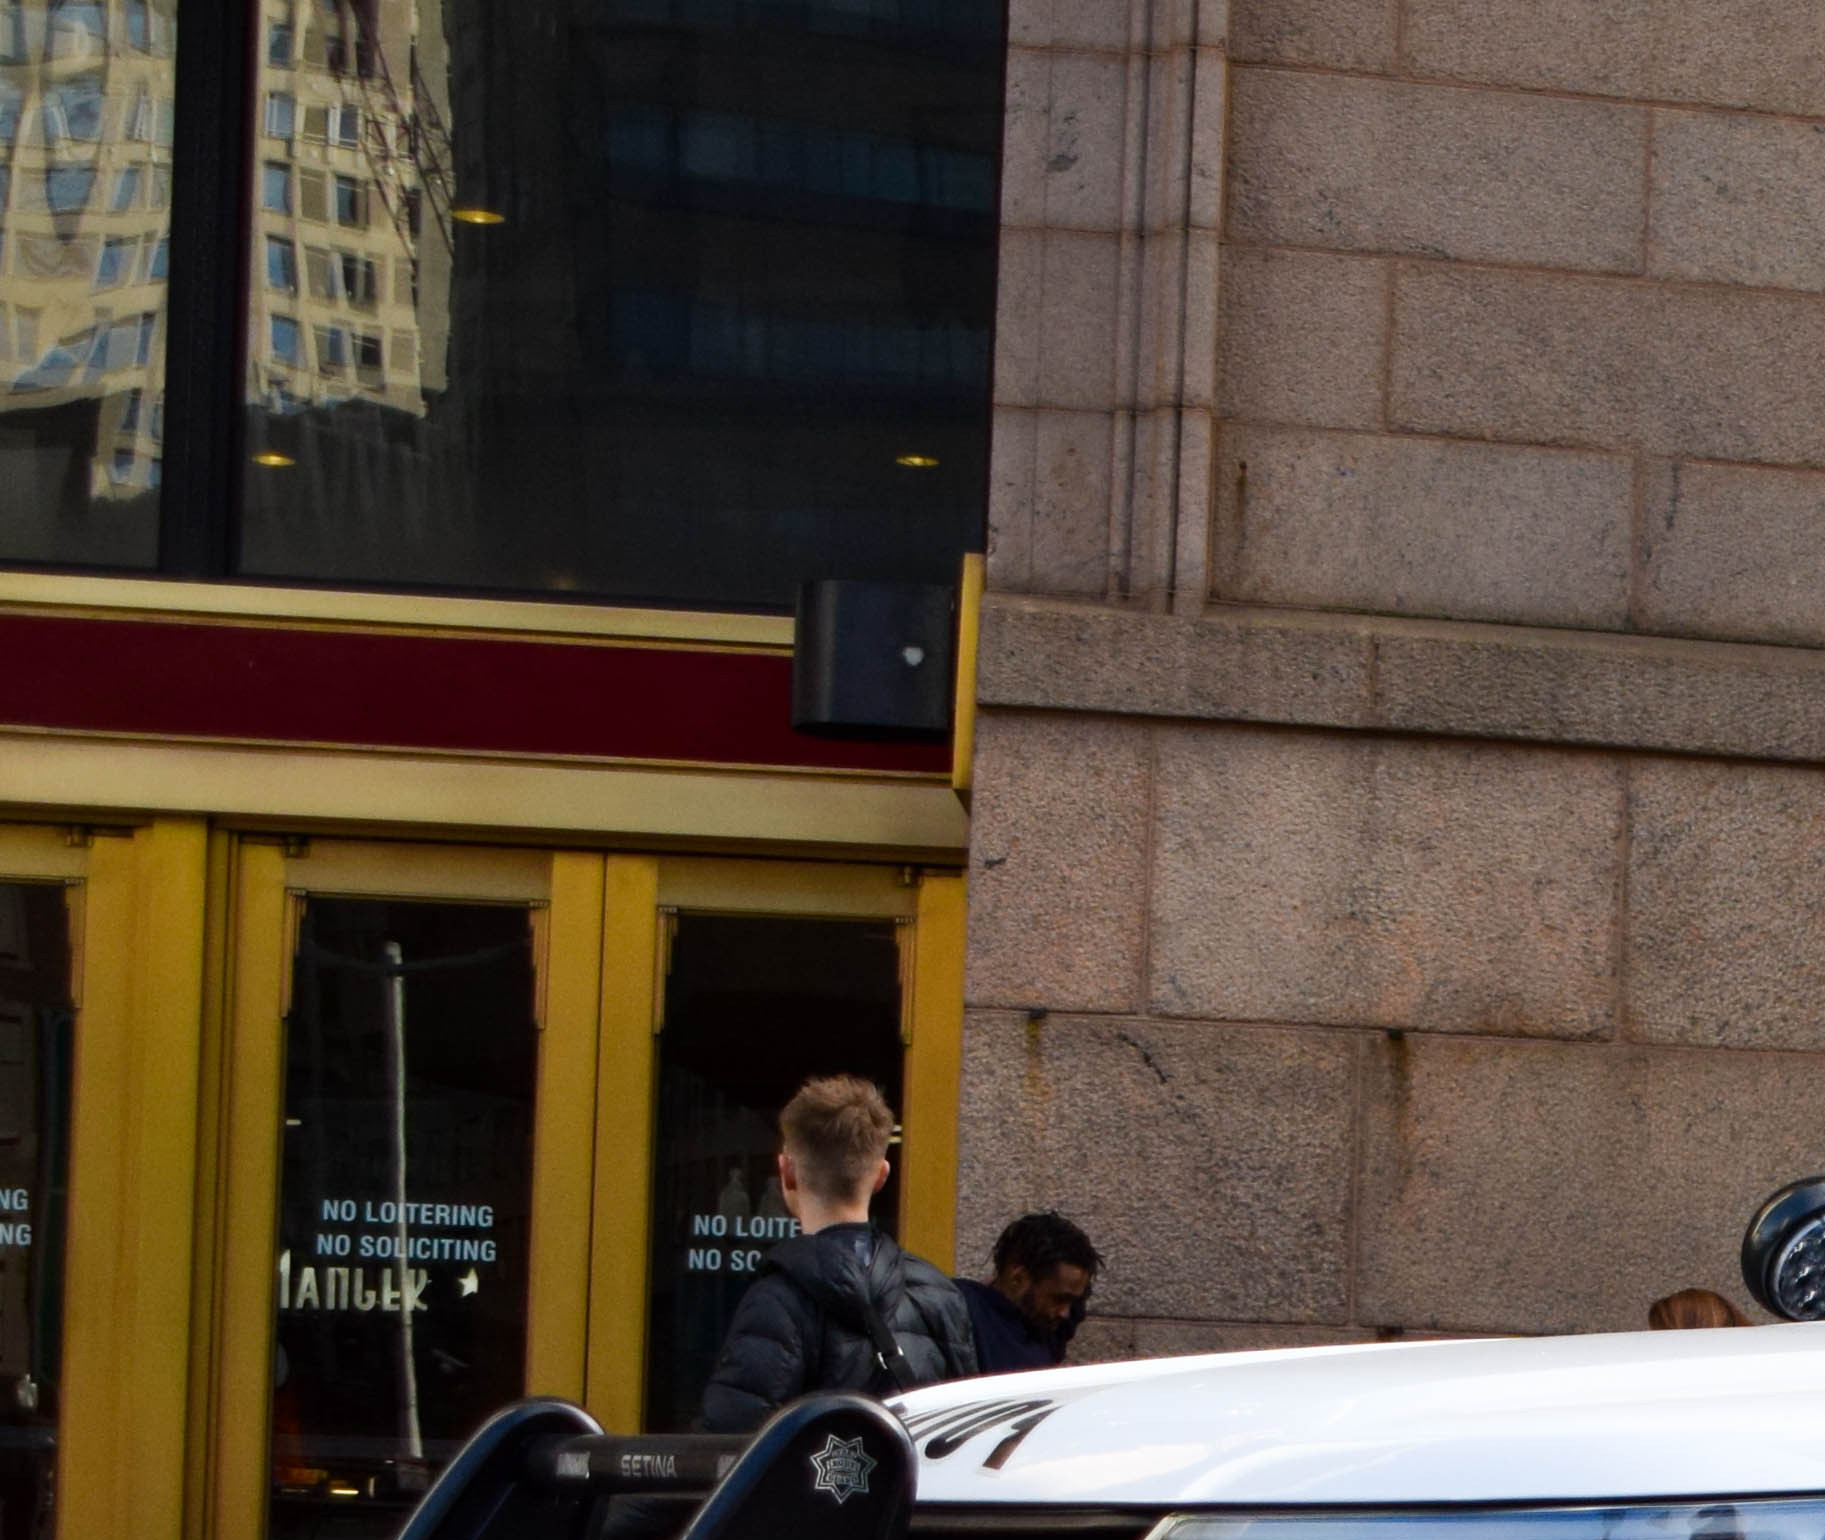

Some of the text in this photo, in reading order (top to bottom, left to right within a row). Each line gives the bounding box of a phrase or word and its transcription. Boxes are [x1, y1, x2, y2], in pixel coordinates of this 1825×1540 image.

[323, 1199, 494, 1228] NO LOITERING
[694, 1214, 728, 1237] NO
[316, 1233, 497, 1262] NO SOLICITING
[688, 1248, 722, 1271] NO
[619, 1454, 678, 1479] SETINA
